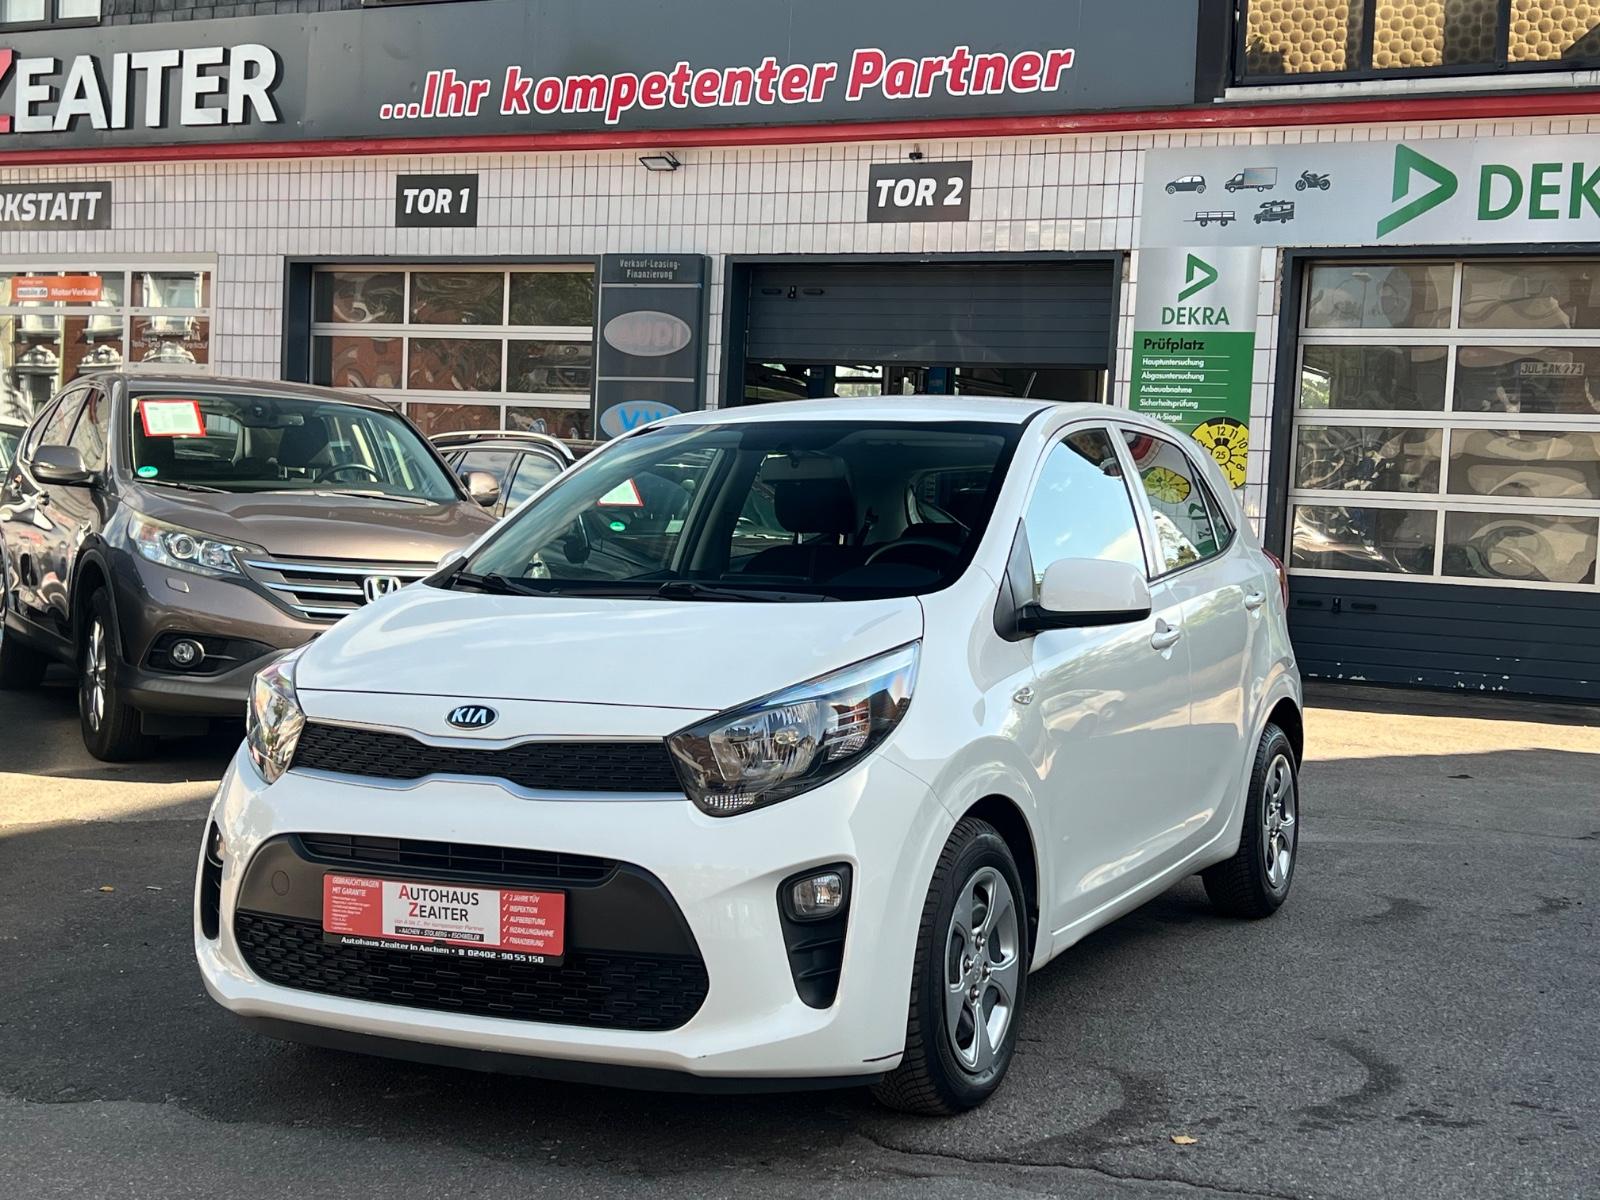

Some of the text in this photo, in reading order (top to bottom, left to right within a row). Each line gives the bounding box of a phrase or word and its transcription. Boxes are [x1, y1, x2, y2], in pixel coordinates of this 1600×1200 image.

[380, 46, 1074, 124] ...Ihr kompetenter Partner
[876, 177, 964, 208] TOR 2
[403, 188, 470, 214] TOR 1
[626, 269, 673, 280] Finanzierung
[1161, 306, 1230, 325] DEKRA
[1143, 338, 1205, 353] Prüfplatz
[1142, 357, 1205, 368] Hauptuntersuchung
[1141, 371, 1205, 382] Abgasuntersuchung
[1140, 385, 1193, 394] Anbauabnahme
[1140, 398, 1199, 409] Sicherheitsprüfung
[1217, 426, 1226, 436] 12
[1229, 428, 1239, 440] 11
[1236, 437, 1248, 450] 10
[1215, 451, 1226, 460] 25
[451, 707, 488, 724] KIA
[399, 884, 480, 906] AUTOHAUS
[408, 902, 469, 922] ZEAITER
[341, 936, 379, 947] Autohaus
[380, 940, 409, 950] Zeaiter
[419, 944, 450, 955] Aachen
[467, 949, 497, 959] 02402
[528, 955, 545, 964] 150
